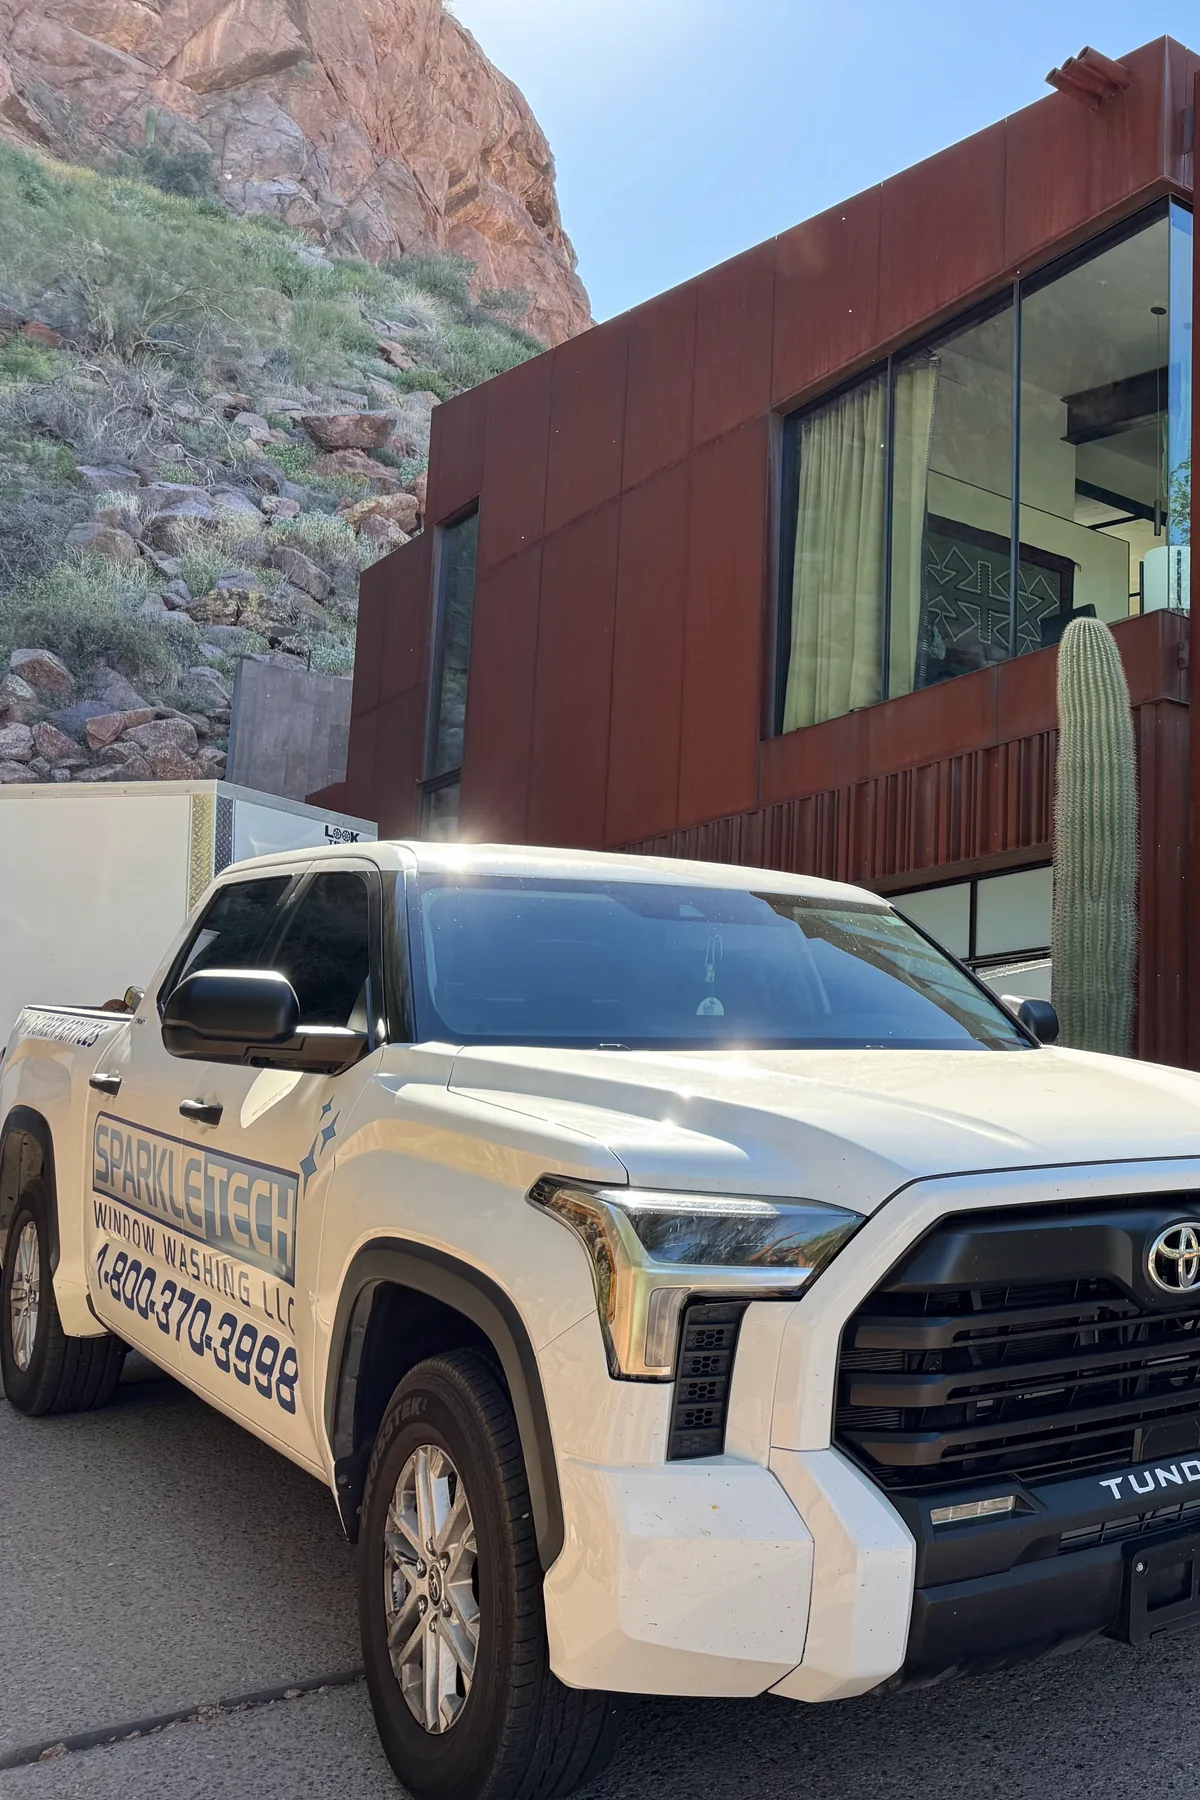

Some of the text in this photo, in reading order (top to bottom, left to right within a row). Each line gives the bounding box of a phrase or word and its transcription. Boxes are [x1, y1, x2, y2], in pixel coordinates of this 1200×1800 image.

[325, 825, 360, 843] LOOK
[54, 1019, 110, 1047] SERVICES
[95, 1124, 295, 1268] SPARKLETECH
[94, 1200, 296, 1336] WINDOW WASHING LLC
[96, 1243, 299, 1415] 1-800-370-3998
